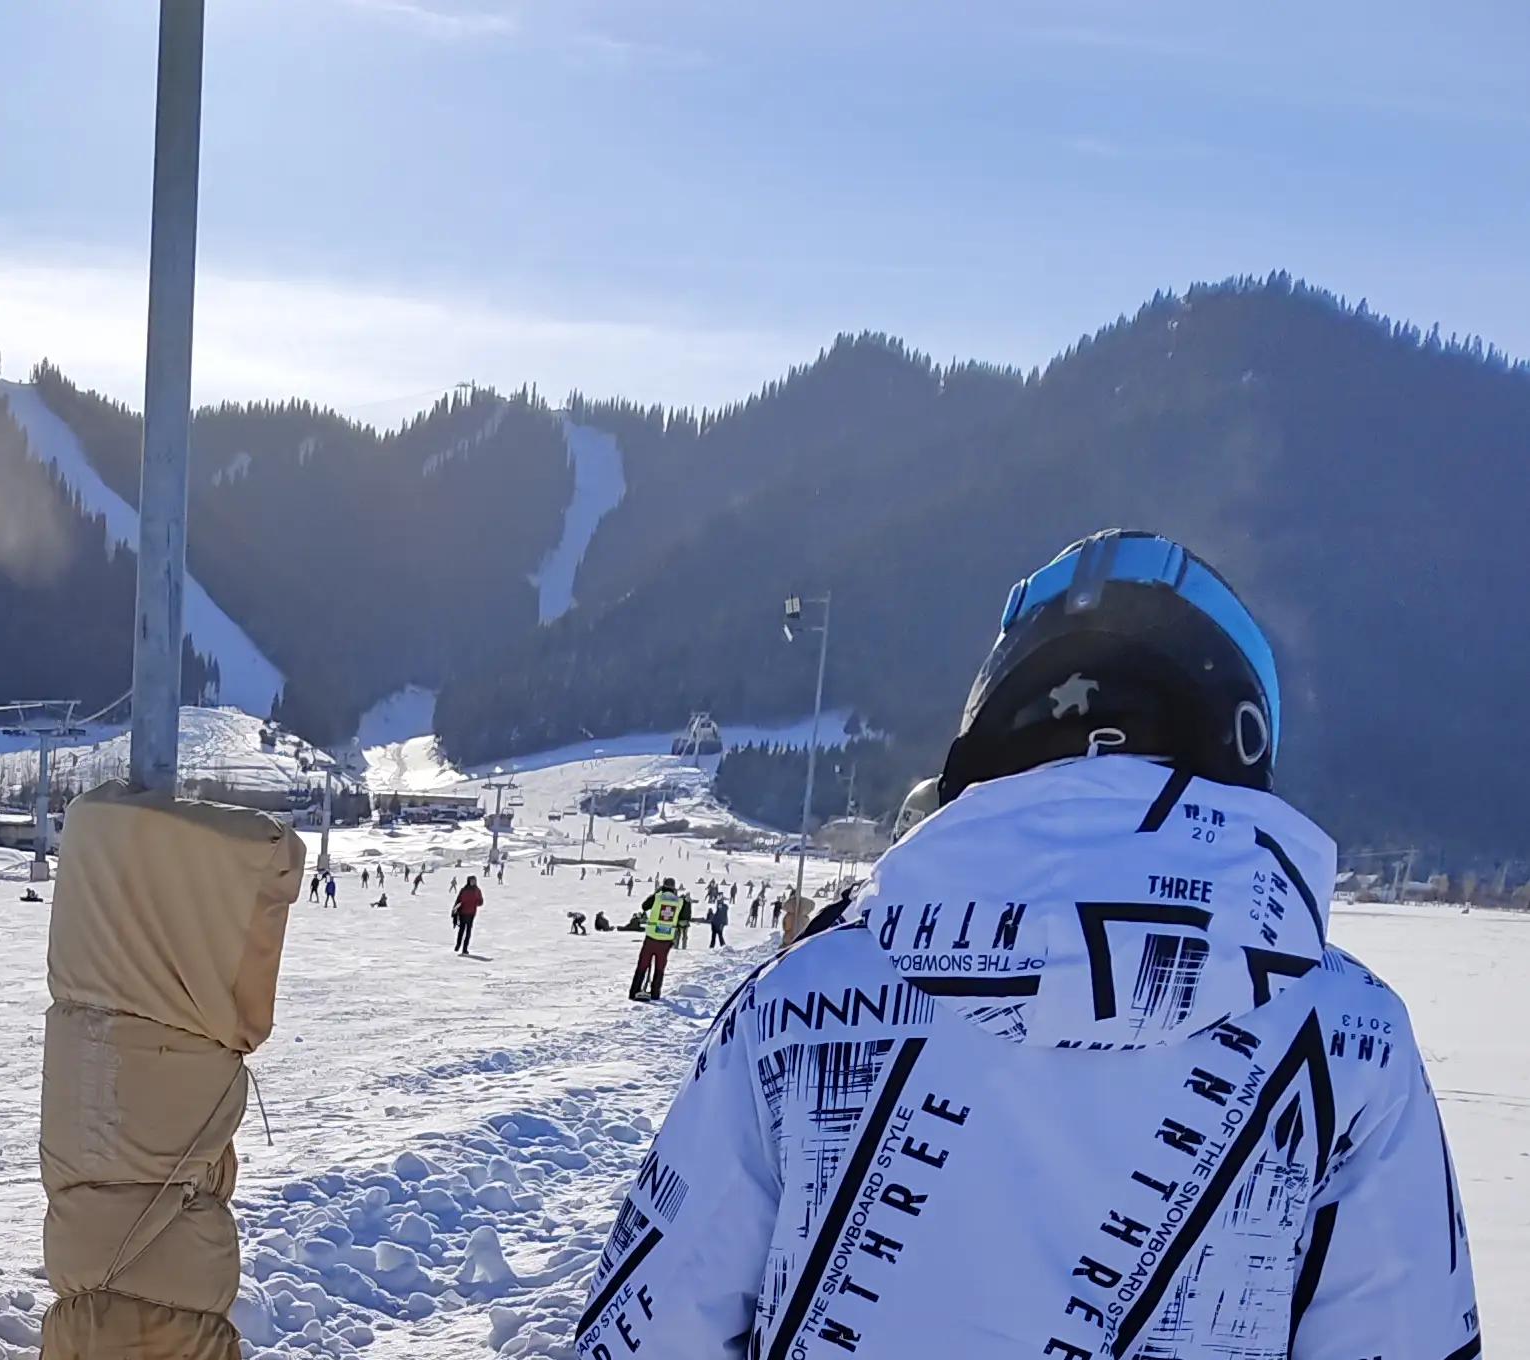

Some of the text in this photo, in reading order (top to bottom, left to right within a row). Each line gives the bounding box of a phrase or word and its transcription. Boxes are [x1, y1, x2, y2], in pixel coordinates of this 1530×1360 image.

[1191, 826, 1216, 844] 20
[1147, 874, 1214, 904] THREE
[1249, 870, 1267, 921] 2013
[862, 901, 1028, 951] NTHR
[976, 954, 1012, 973] THE
[1016, 957, 1047, 971] OF
[1235, 1064, 1266, 1108] NNN
[1220, 1107, 1244, 1140] OF
[1191, 1139, 1228, 1180] THE
[802, 1296, 830, 1334] THE
[821, 1171, 885, 1297] SNOWBOARD
[881, 1105, 915, 1170] STYLE
[1117, 1180, 1201, 1303] SNOWBOARD
[600, 1281, 634, 1329] STYLE
